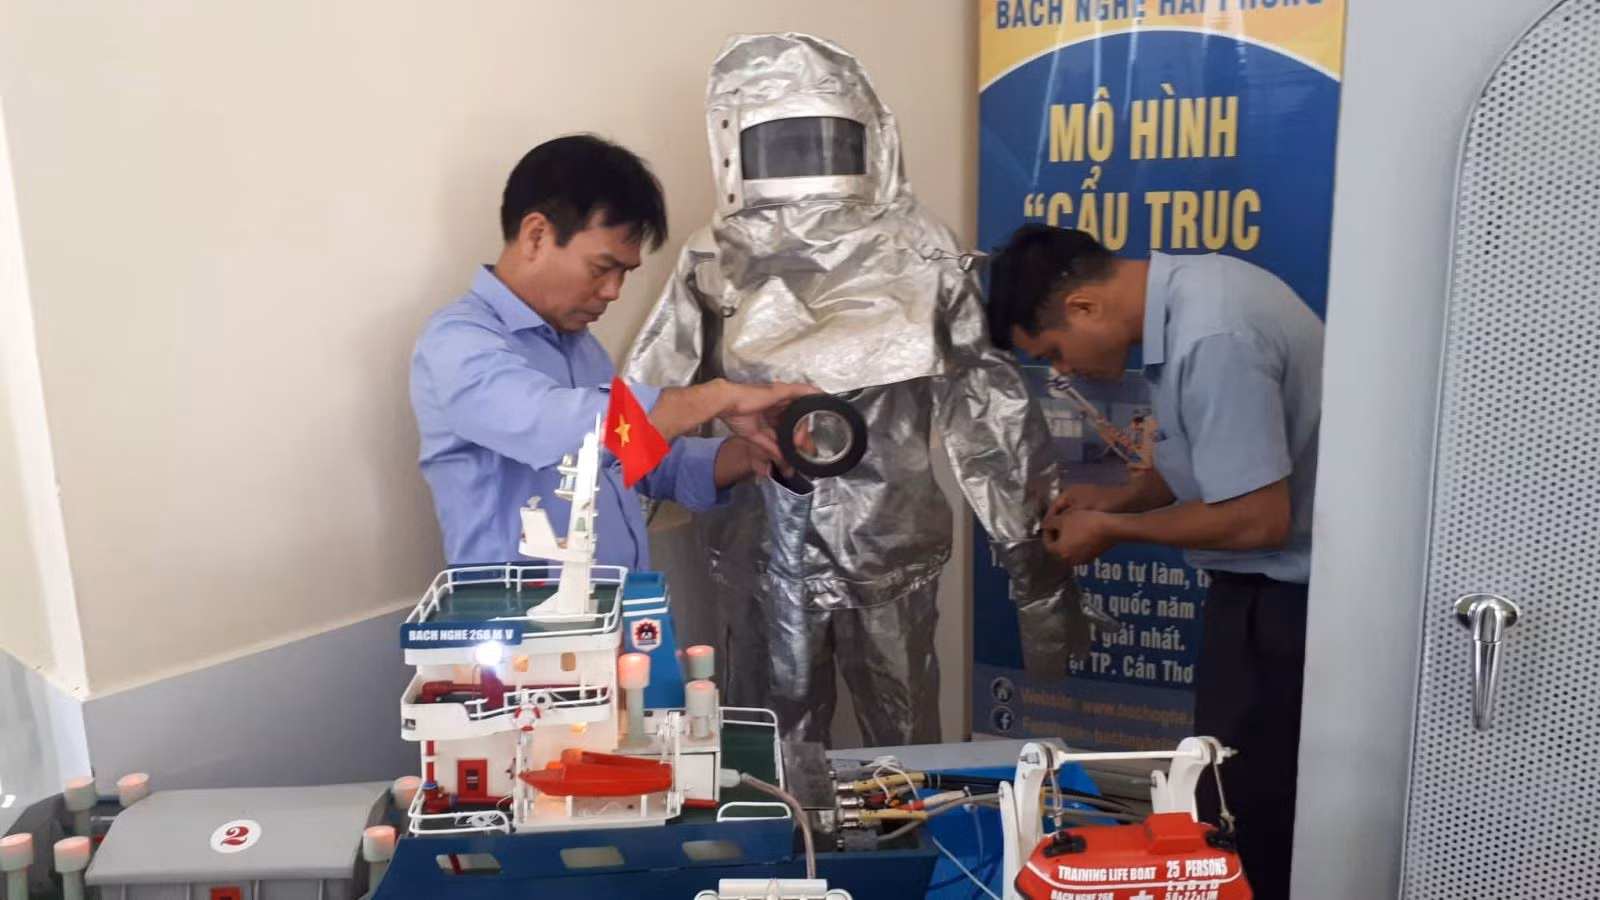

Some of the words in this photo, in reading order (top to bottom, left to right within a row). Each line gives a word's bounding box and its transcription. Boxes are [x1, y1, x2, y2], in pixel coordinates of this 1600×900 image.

[1049, 87, 1114, 162] MÔ
[1130, 83, 1239, 160] HÌNH
[1094, 557, 1122, 584] tạo
[1128, 561, 1147, 588] tự
[1152, 561, 1191, 590] làm,
[1109, 590, 1151, 617] quốc
[1157, 596, 1195, 619] năm
[408, 629, 438, 641] BACH
[440, 629, 468, 641] NGHE
[1140, 625, 1186, 651] nhất.
[1090, 652, 1117, 676] TP.
[1162, 660, 1195, 684] Thơ
[220, 826, 249, 846] 2
[1058, 865, 1107, 882] TRAINING
[1109, 867, 1129, 881] LIFE
[1130, 866, 1157, 881] BOAT
